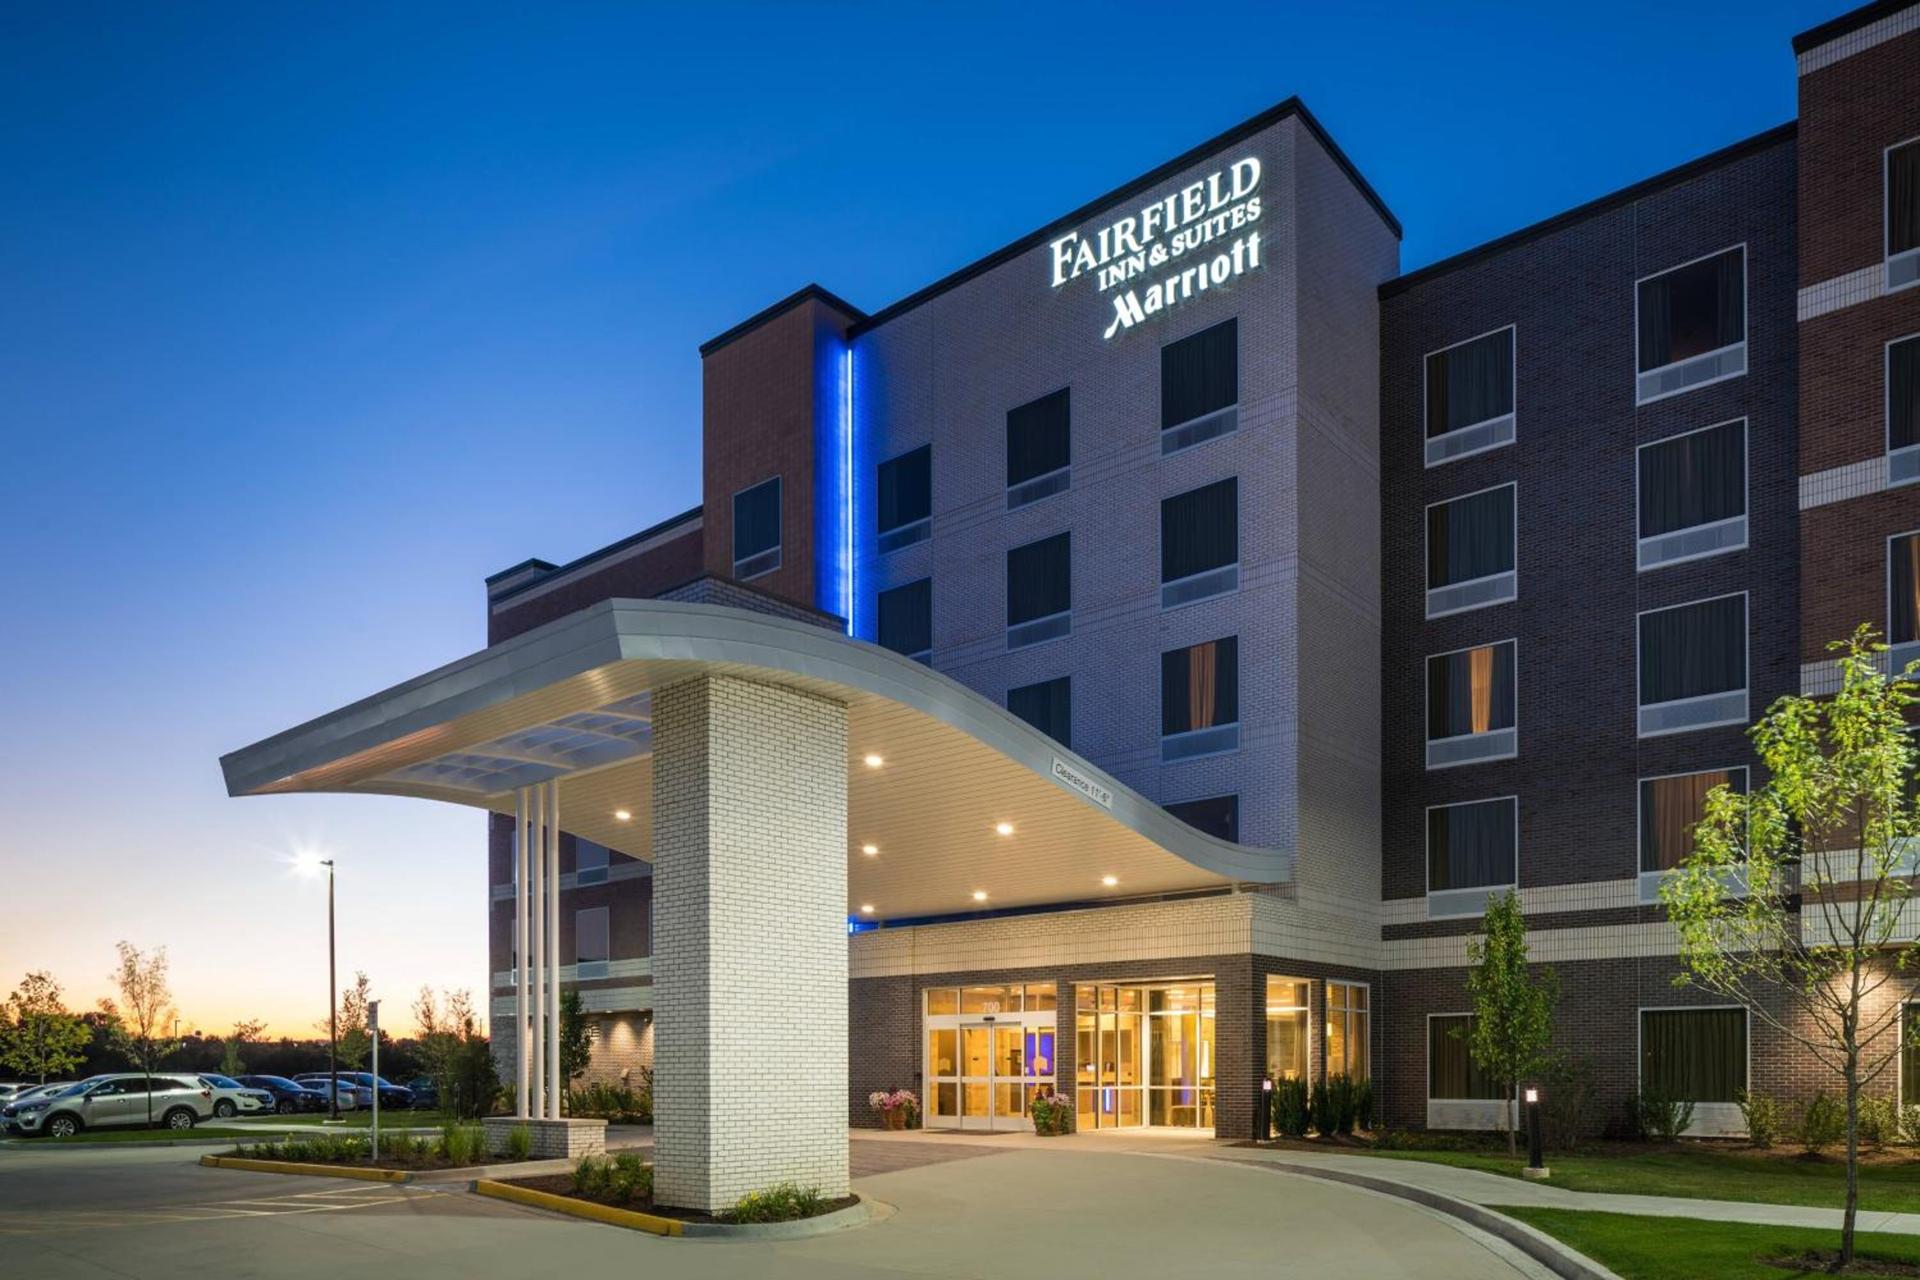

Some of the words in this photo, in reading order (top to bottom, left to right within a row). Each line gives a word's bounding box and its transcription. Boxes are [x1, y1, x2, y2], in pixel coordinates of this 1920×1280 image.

[1050, 157, 1261, 287] FAIRFIELD
[1098, 250, 1146, 291] INN
[1149, 243, 1169, 267] &
[1171, 197, 1261, 257] SUITES
[1104, 231, 1261, 339] Marriott
[1055, 763, 1089, 792] Clearance
